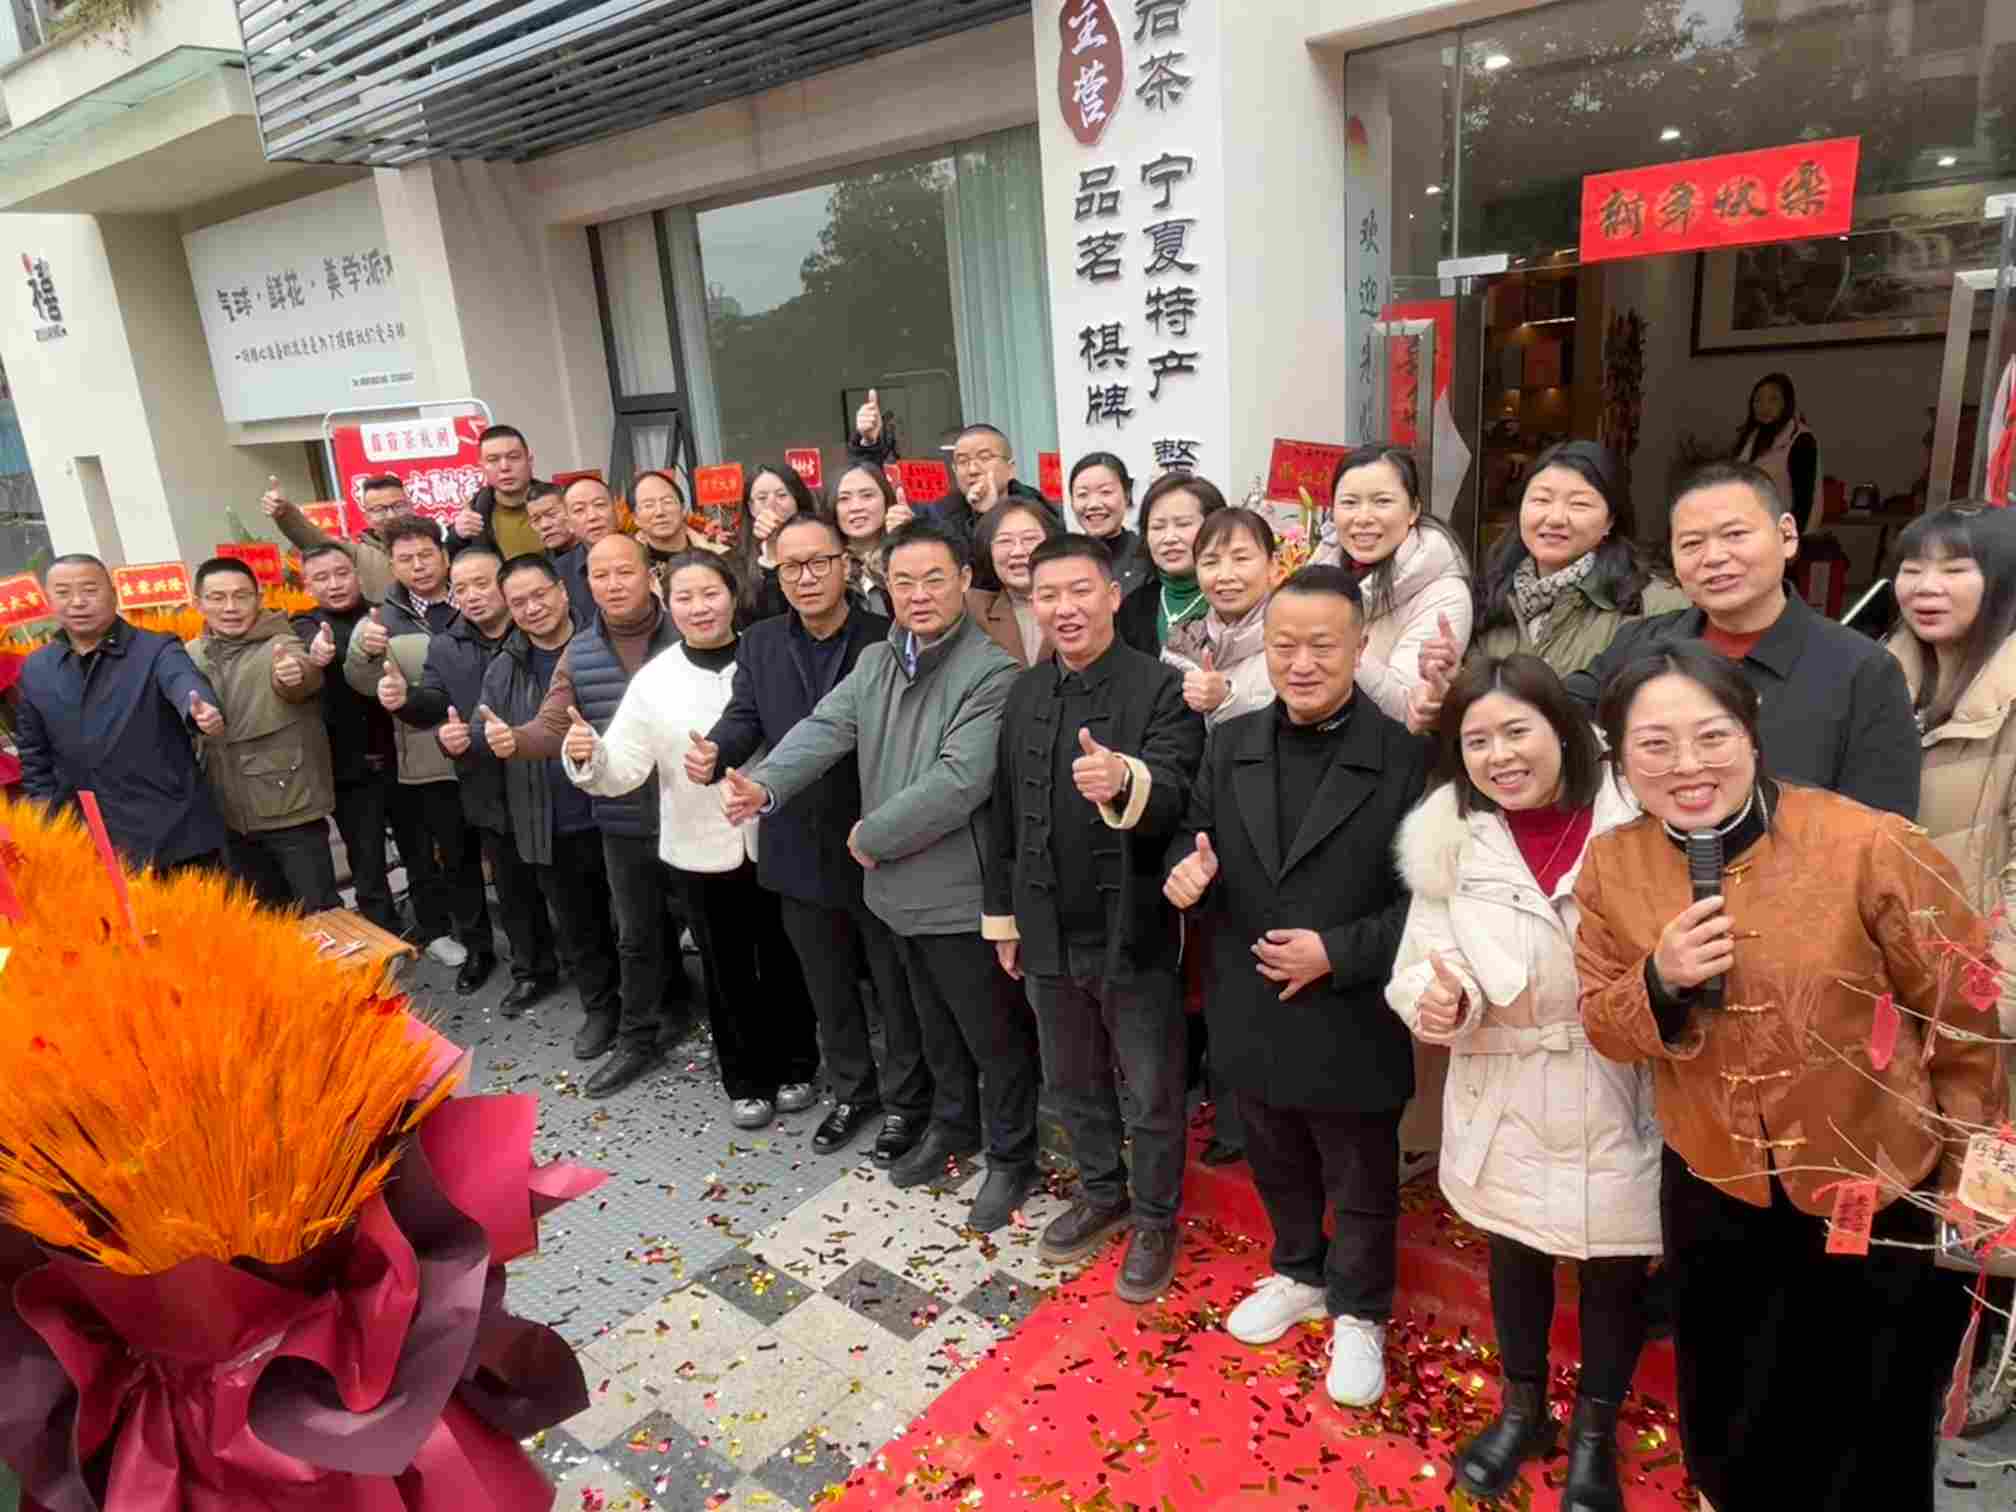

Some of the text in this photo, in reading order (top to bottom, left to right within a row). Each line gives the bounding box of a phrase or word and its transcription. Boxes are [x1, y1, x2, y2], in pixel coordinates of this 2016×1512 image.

[1068, 1, 1107, 129] 主营
[1074, 164, 1133, 430] 品茗 棋牌
[1140, 152, 1198, 401] 宁夏特产
